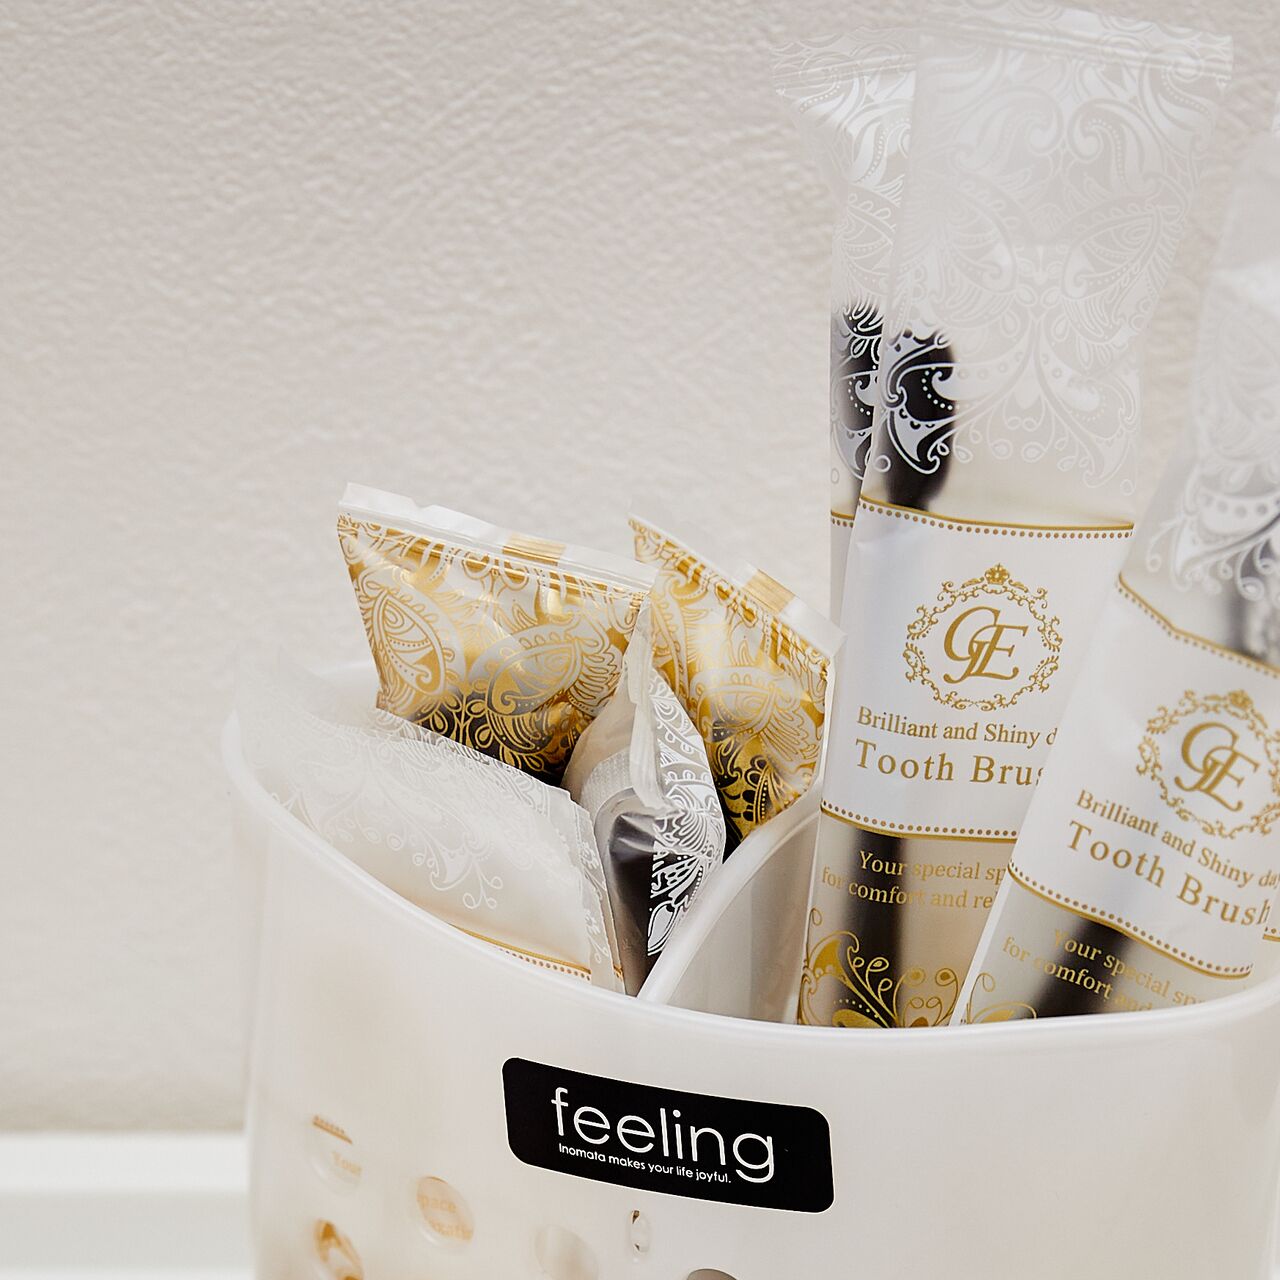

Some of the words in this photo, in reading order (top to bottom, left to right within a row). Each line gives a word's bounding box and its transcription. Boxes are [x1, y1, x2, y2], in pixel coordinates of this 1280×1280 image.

[857, 705, 938, 739] Brilliant
[943, 722, 978, 740] and
[984, 723, 1040, 749] Shiny
[855, 738, 954, 781] Tooth
[859, 850, 907, 876] Your
[913, 862, 981, 881] special
[1076, 789, 1160, 837] Brilliant
[1161, 829, 1196, 858] and
[1198, 847, 1255, 889] Shiny
[823, 867, 843, 889] for
[848, 880, 927, 905] comfort
[932, 890, 969, 908] and
[1067, 820, 1167, 889] Tooth
[1176, 872, 1272, 926] Brush
[1003, 936, 1032, 962] for
[1034, 956, 1113, 1000] comfort
[1054, 928, 1102, 962] Your
[1103, 953, 1170, 998] special
[551, 1086, 775, 1184] feeling
[558, 1142, 606, 1163] Inomata
[608, 1155, 646, 1170] makes
[648, 1162, 674, 1174] your
[676, 1165, 694, 1179] life
[695, 1168, 732, 1184] joyful.
